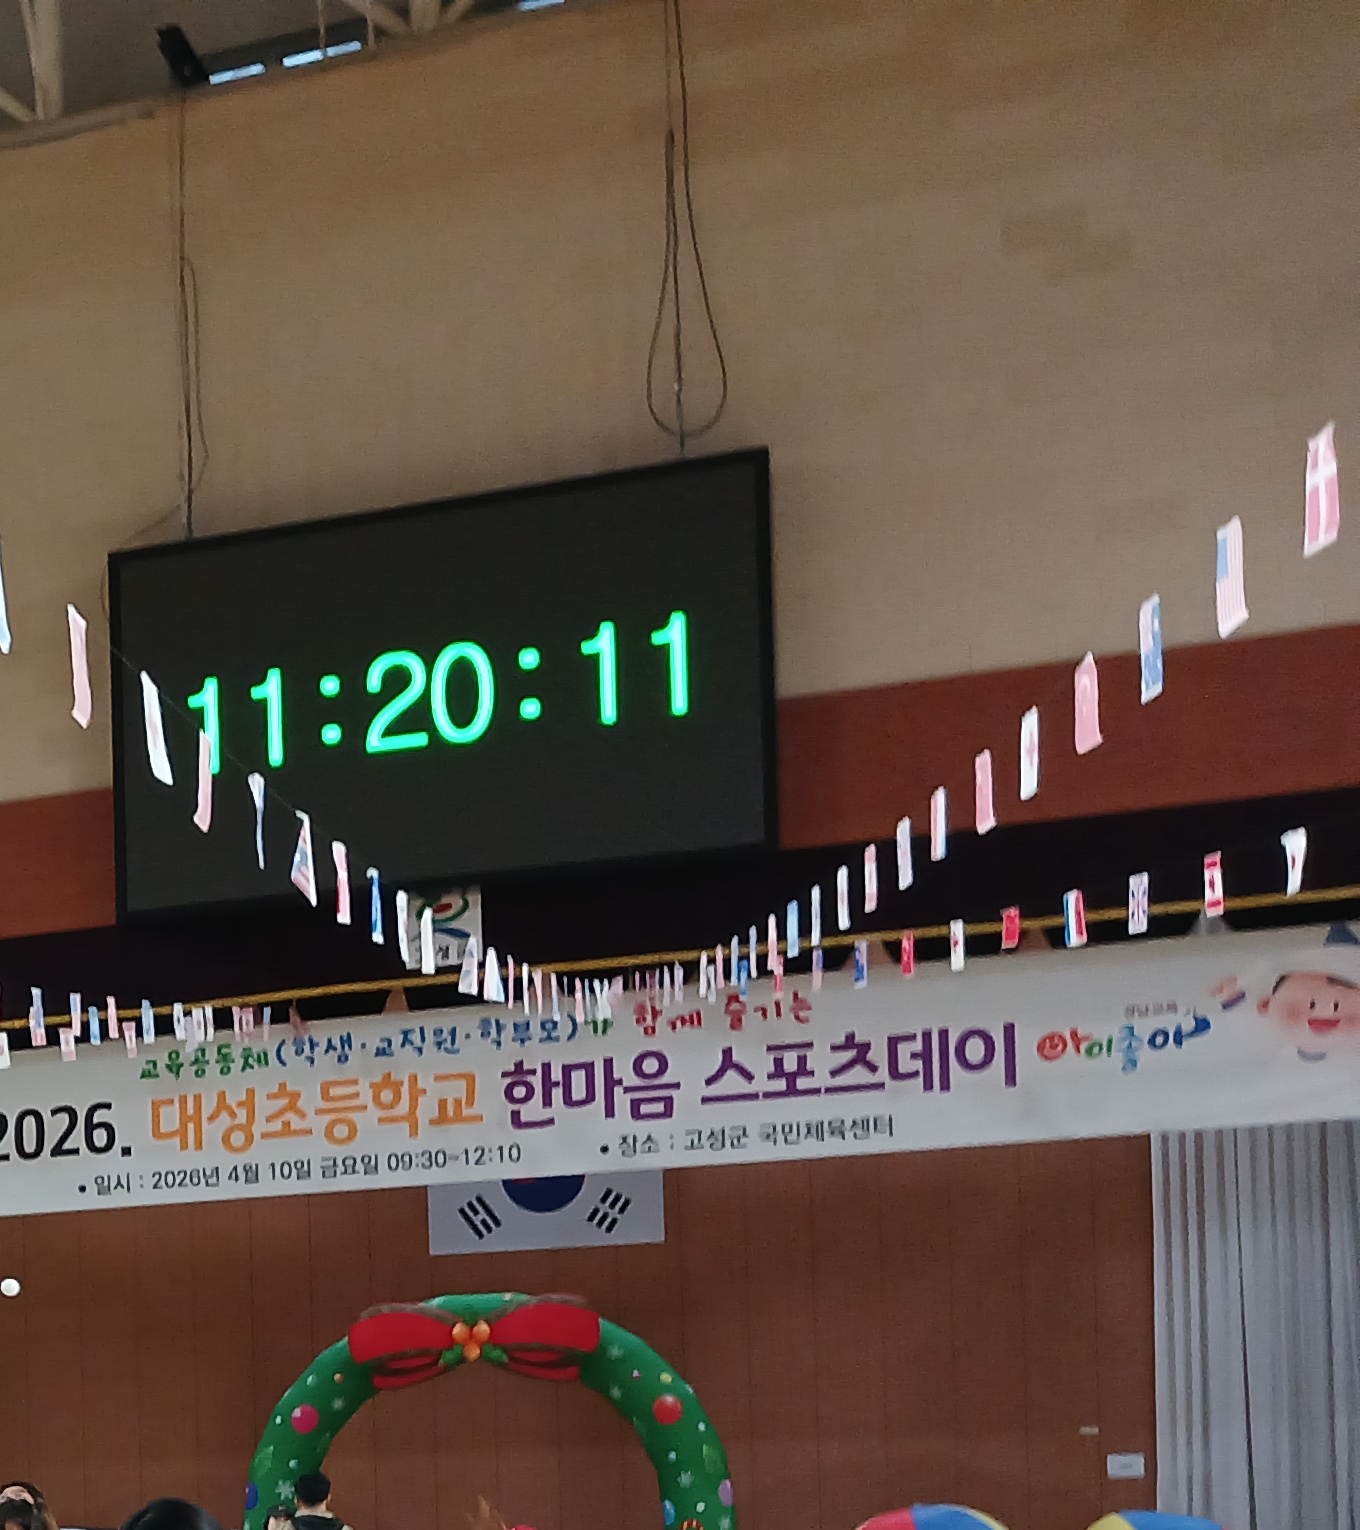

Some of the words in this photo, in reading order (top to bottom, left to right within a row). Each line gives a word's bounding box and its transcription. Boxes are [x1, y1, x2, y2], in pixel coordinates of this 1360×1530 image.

[187, 610, 688, 774] 11:20:11
[151, 1070, 485, 1154] 대성초등학교
[500, 1049, 681, 1131] 한마음
[701, 1021, 1017, 1105] 스포츠데이
[94, 1173, 131, 1196] 일시
[152, 1165, 220, 1191] 2026년
[227, 1162, 260, 1185] 4월
[268, 1157, 312, 1181] 10일
[320, 1154, 379, 1180] 금요일
[618, 1132, 660, 1157] 장소
